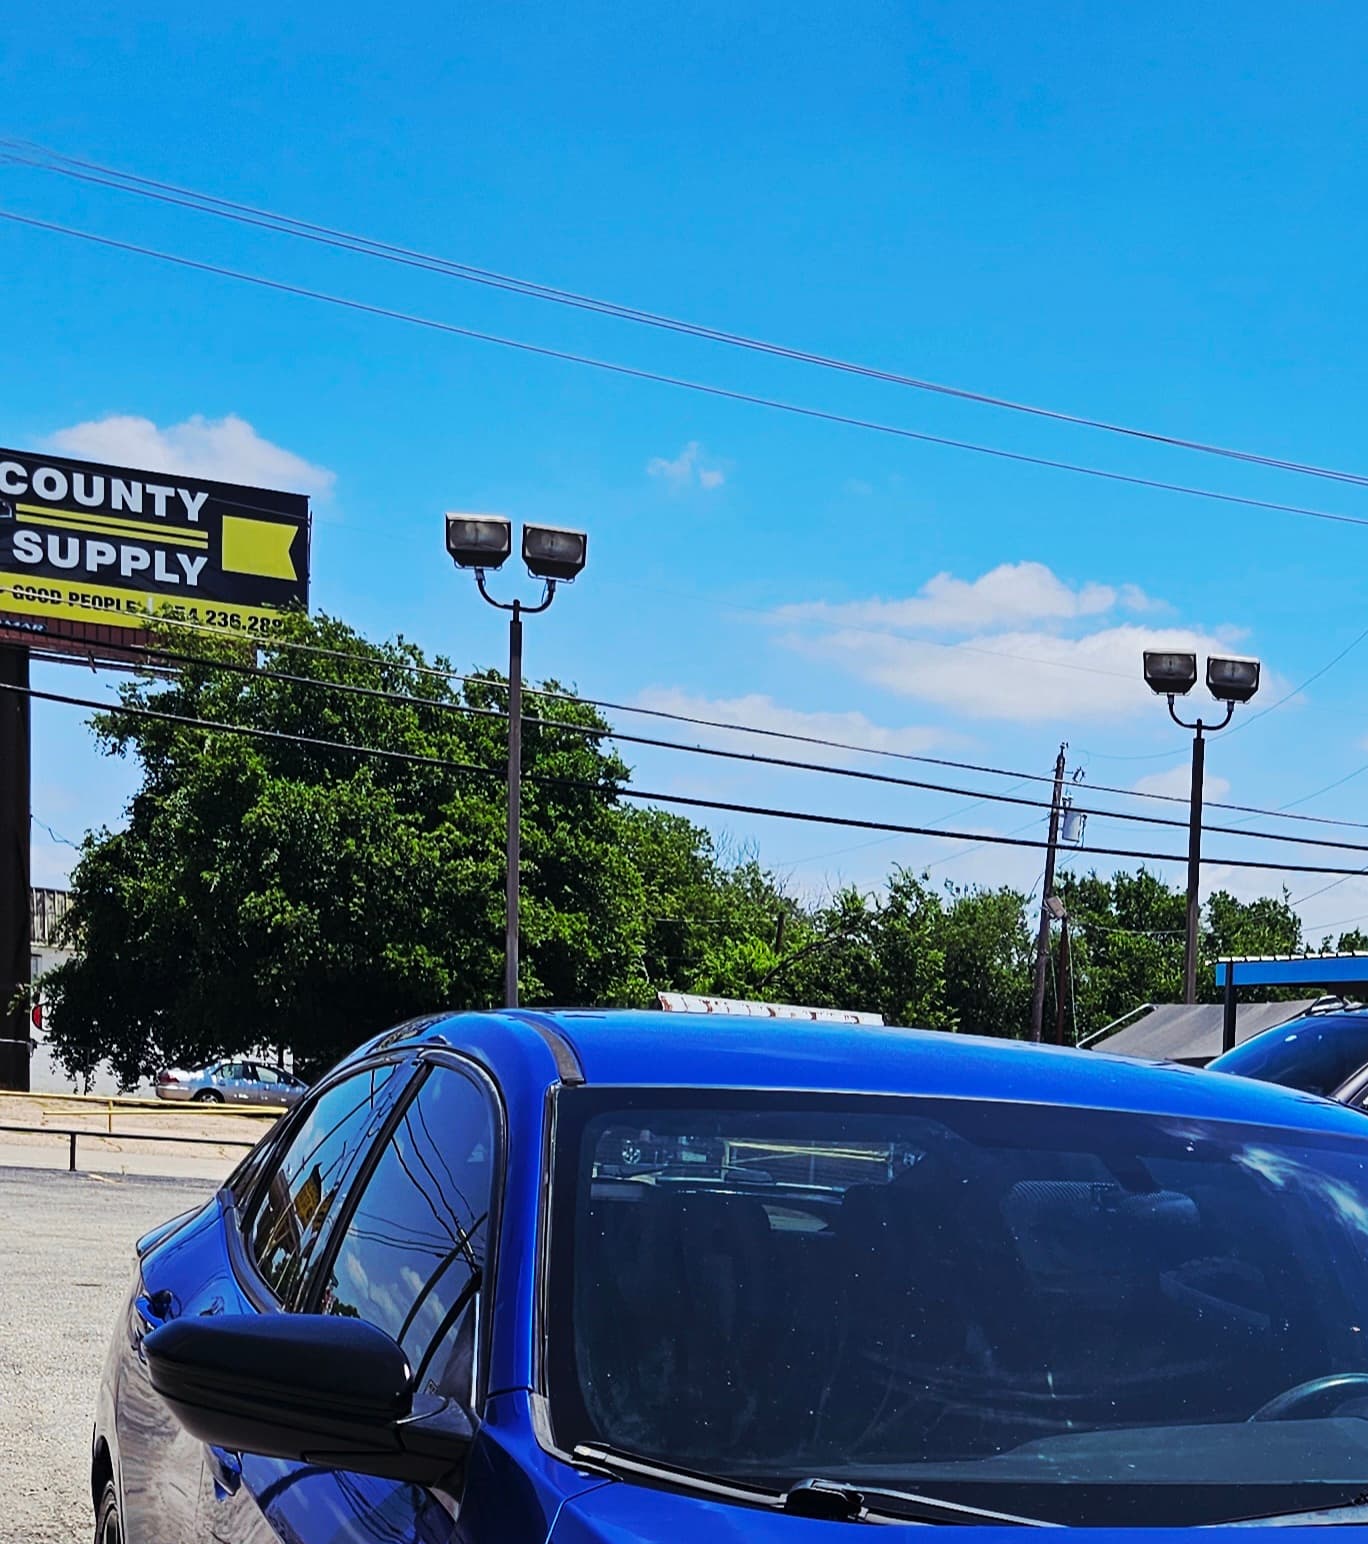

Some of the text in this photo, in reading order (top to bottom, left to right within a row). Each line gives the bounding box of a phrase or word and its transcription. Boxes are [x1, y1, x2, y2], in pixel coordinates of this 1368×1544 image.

[0, 461, 209, 522] COUNTY
[12, 530, 208, 587] SUPPLY
[13, 585, 62, 605] GOOD
